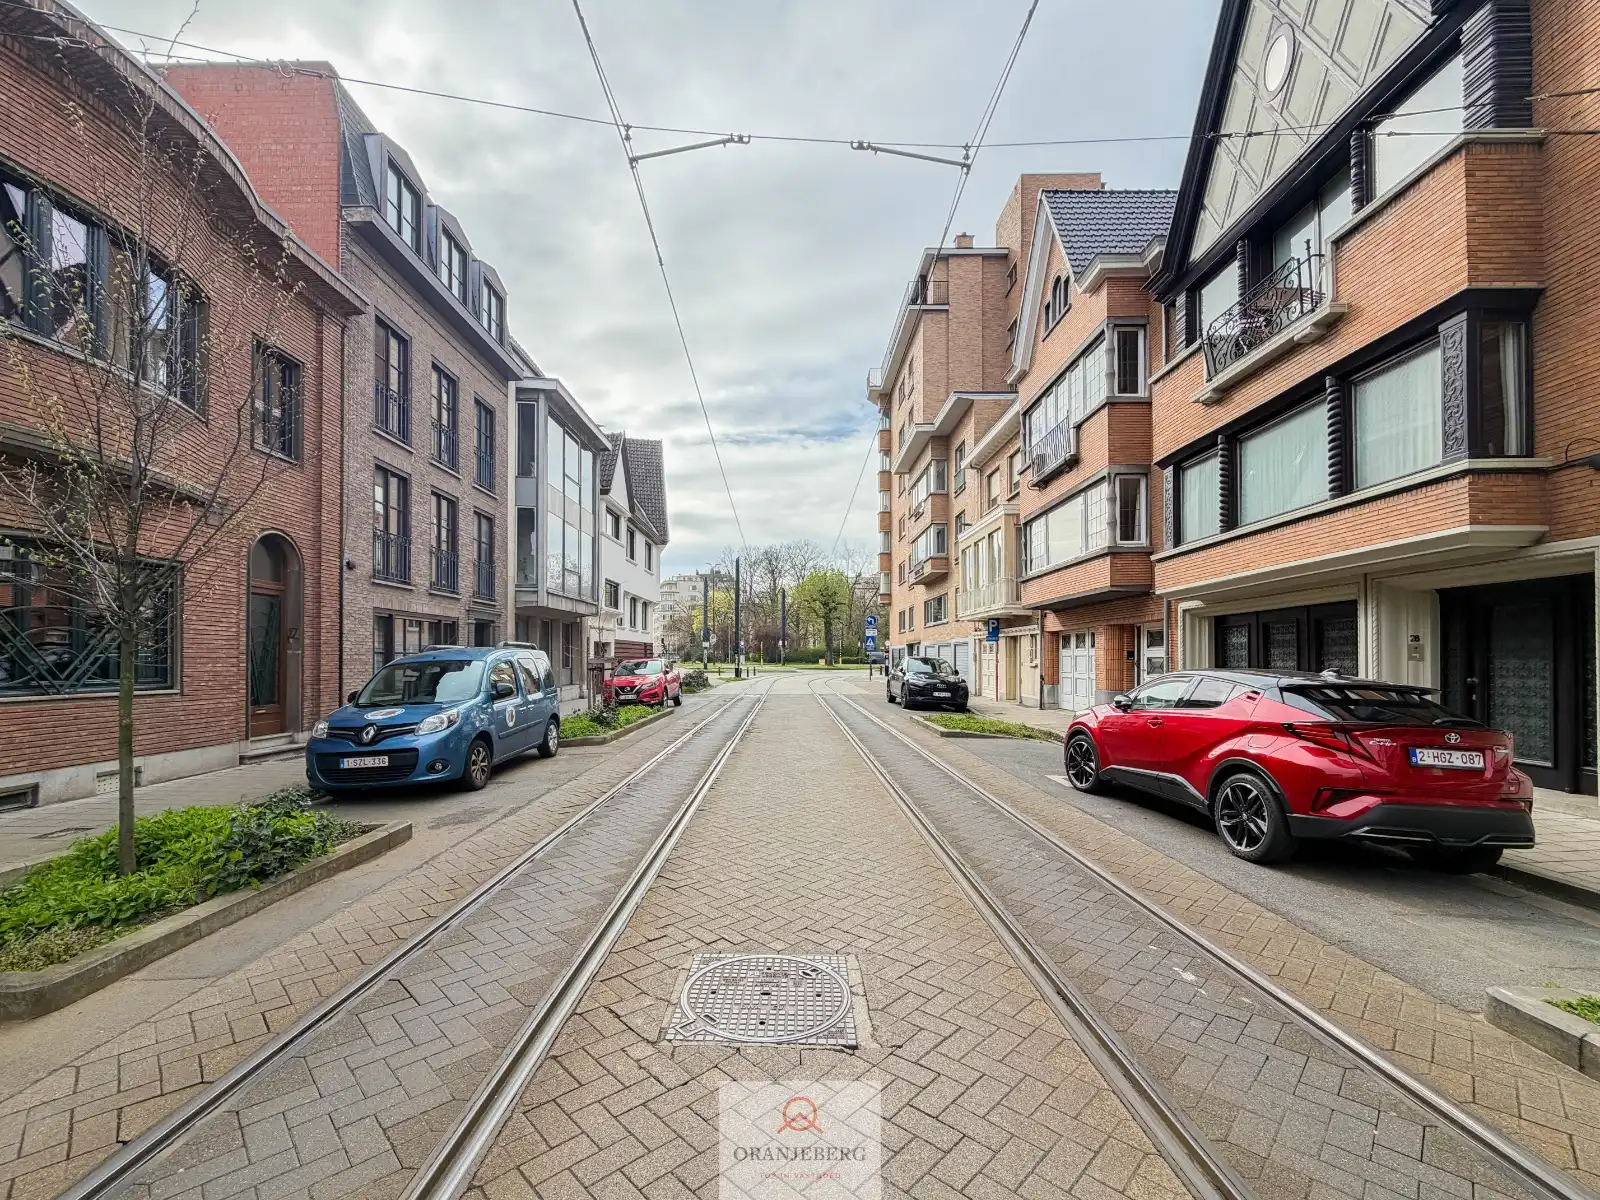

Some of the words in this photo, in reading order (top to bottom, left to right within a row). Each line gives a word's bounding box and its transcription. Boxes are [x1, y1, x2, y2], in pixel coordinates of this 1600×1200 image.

[988, 619, 998, 633] P
[1409, 634, 1421, 643] 28
[346, 757, 387, 767] 1-SZL-336
